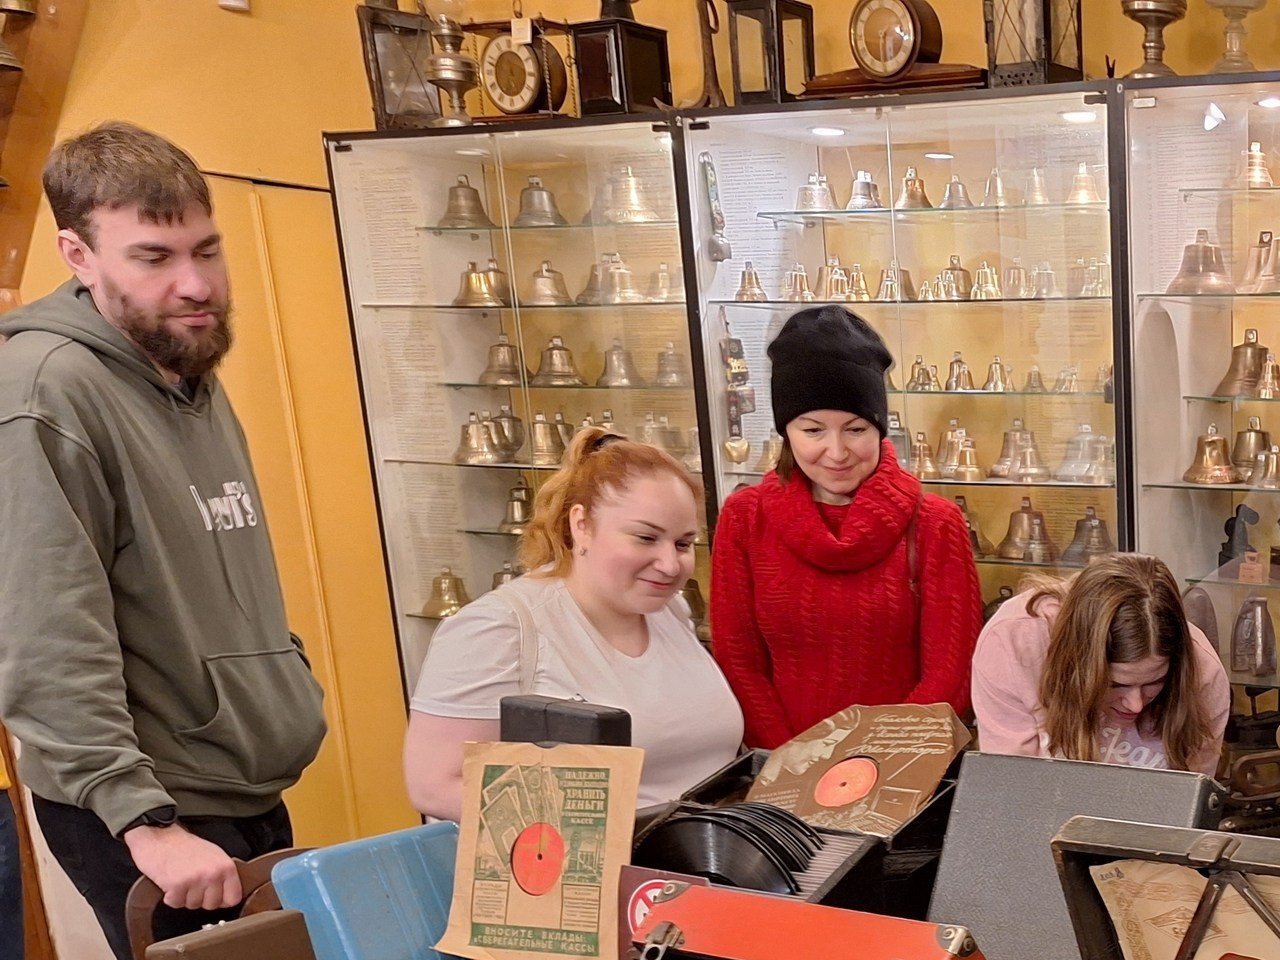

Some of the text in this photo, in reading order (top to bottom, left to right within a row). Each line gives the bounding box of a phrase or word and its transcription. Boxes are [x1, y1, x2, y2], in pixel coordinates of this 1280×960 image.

[564, 800, 604, 810] ДЕНЬГИ
[485, 926, 534, 938] ВНОСИТЕ
[561, 942, 595, 953] КАССЫ
